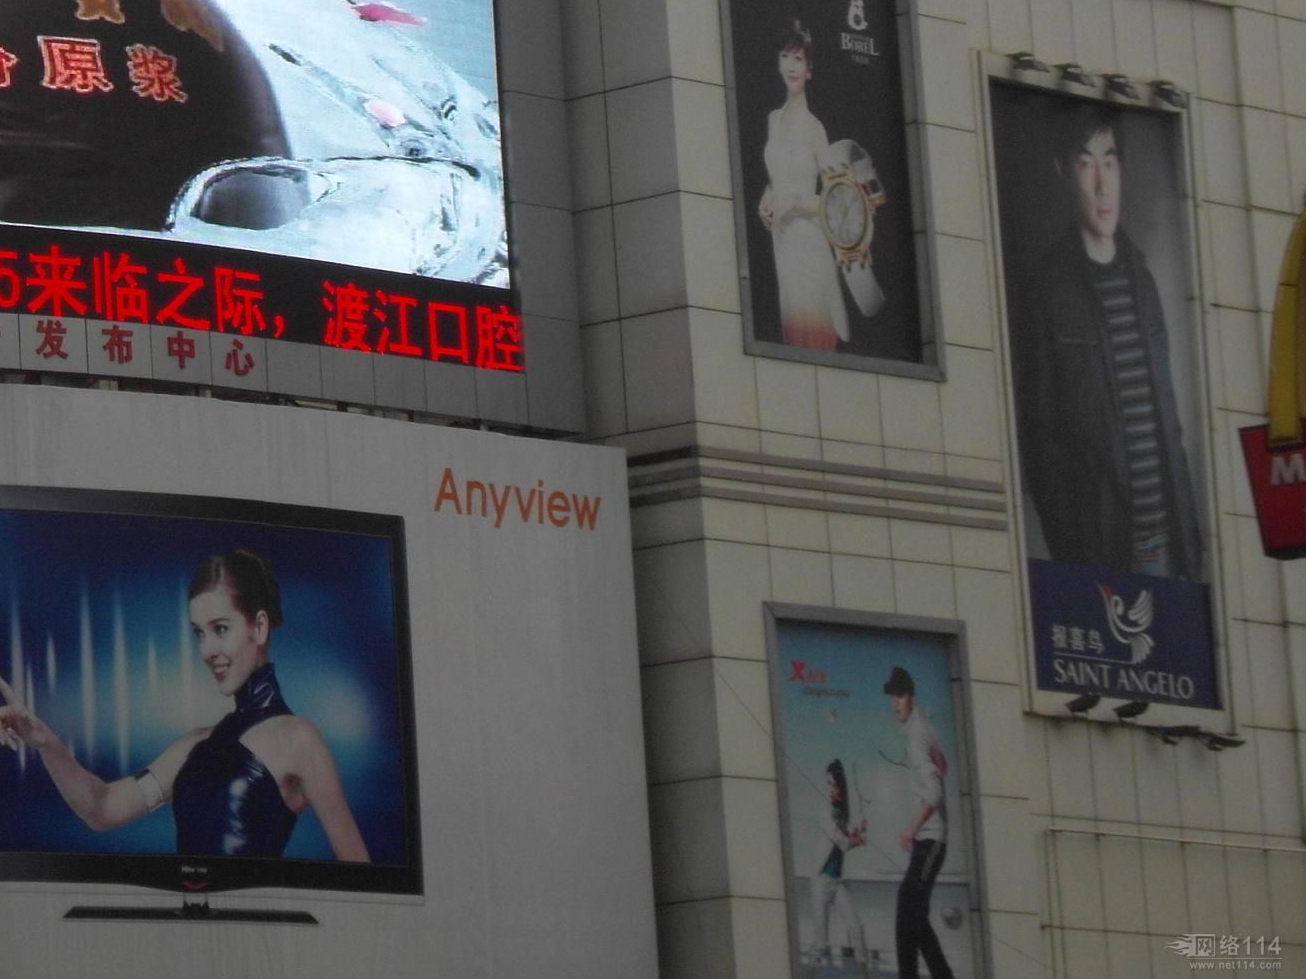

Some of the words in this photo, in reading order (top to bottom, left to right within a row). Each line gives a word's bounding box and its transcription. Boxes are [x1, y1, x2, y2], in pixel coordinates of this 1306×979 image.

[434, 467, 601, 531] Anyview
[1053, 658, 1111, 689] SAINT
[1118, 667, 1194, 699] ANGELO
